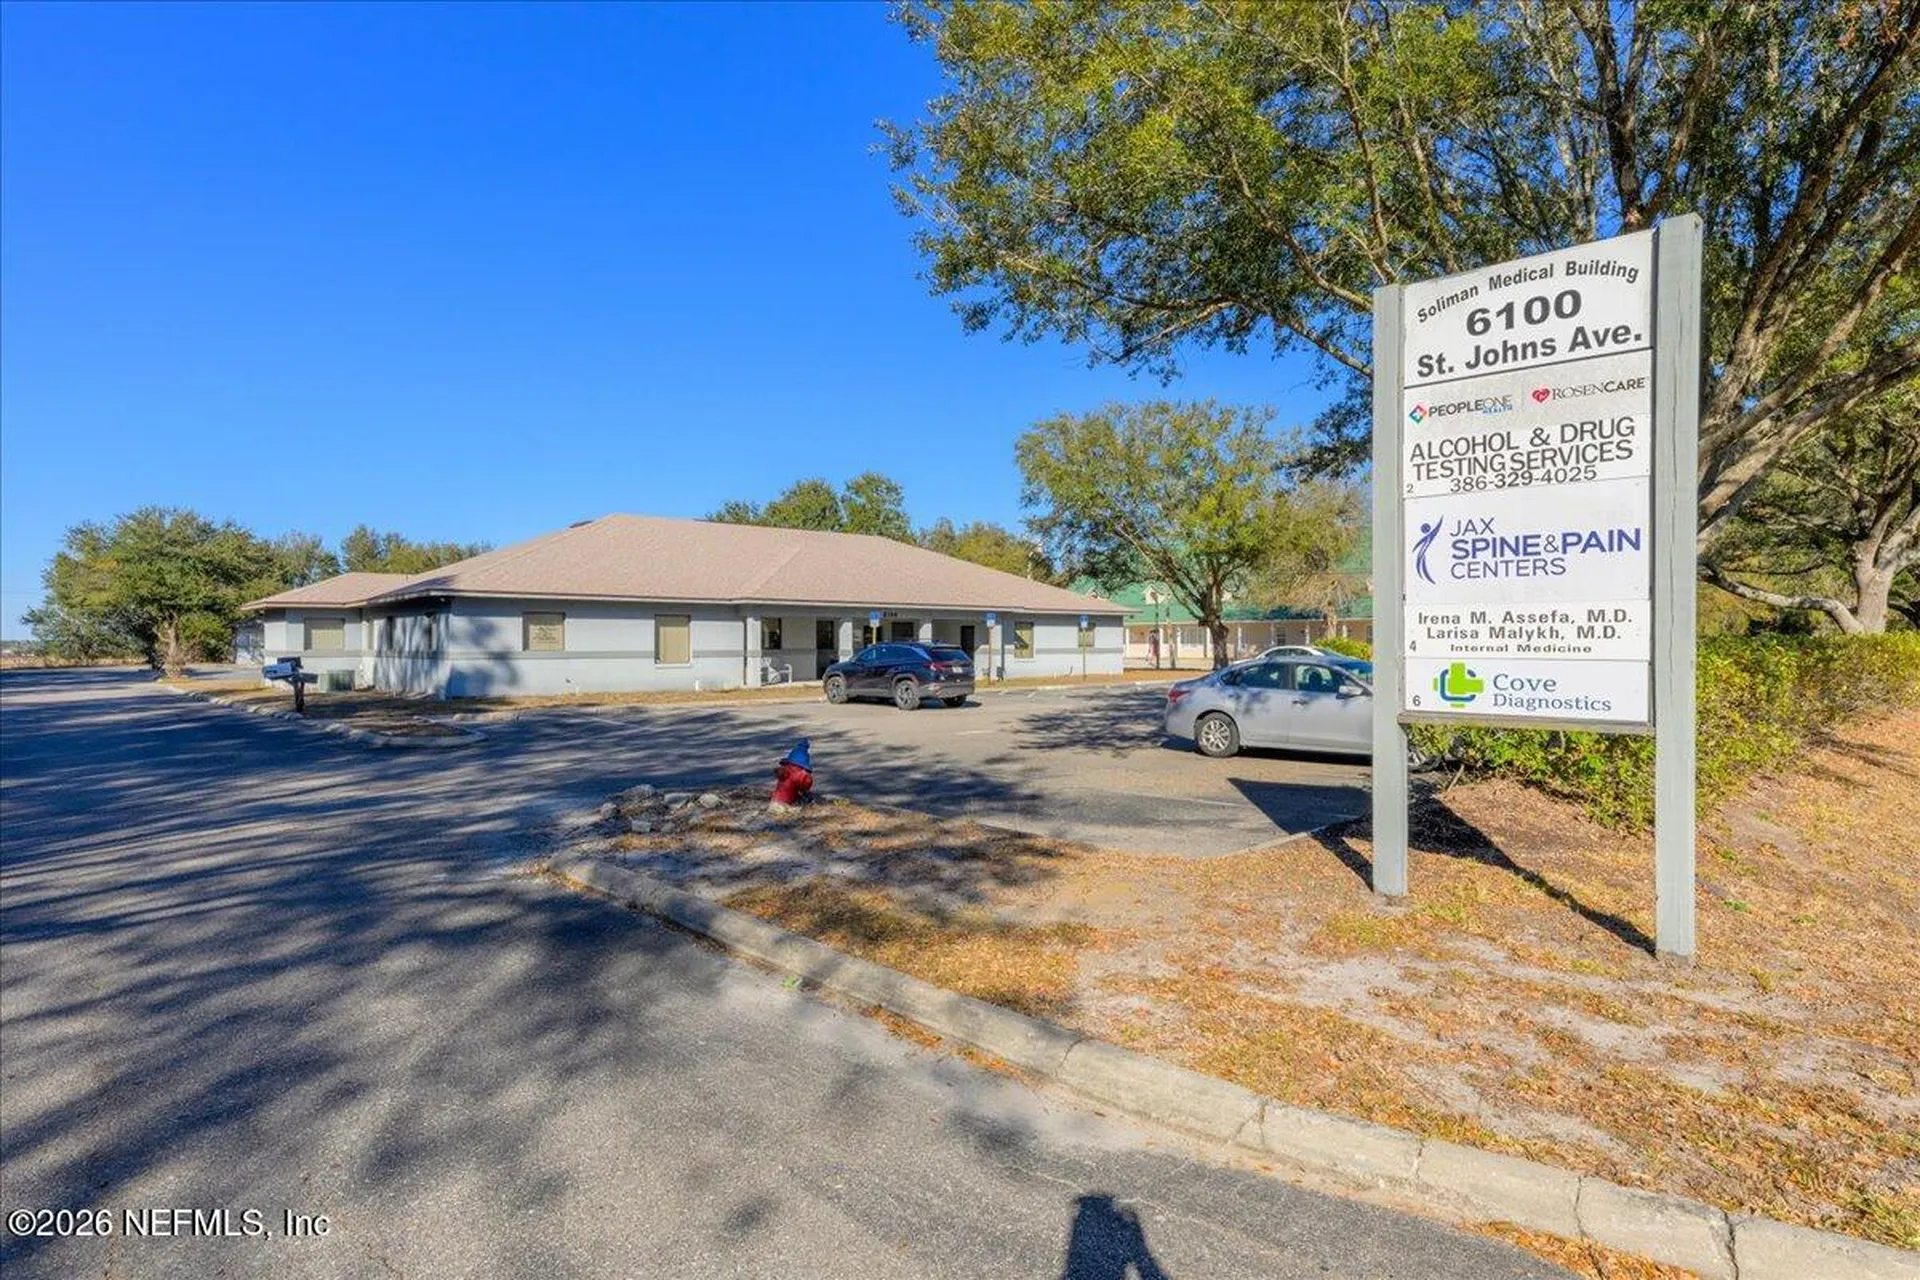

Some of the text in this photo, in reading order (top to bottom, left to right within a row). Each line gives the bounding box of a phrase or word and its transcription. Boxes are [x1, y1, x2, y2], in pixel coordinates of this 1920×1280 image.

[1416, 260, 1639, 323] Soliman Medical Building
[1466, 289, 1582, 337] 6100
[1416, 323, 1642, 378] St. Johns Ave.
[1410, 416, 1635, 462] ALCOHOL & DRUG
[1413, 440, 1634, 482] TESTING SERVICES
[1406, 483, 1414, 494] 2
[1450, 465, 1597, 494] 386-329-4025
[1450, 517, 1495, 537] JAX
[1451, 557, 1566, 580] CENTERS
[1418, 609, 1633, 626] Irena M. Assefa, M.D.
[1426, 625, 1622, 644] Larisa Malykh, M.D.
[1409, 640, 1417, 652] 4
[1450, 643, 1592, 654] Internal Medicine
[1493, 673, 1557, 692] Cove
[1412, 695, 1421, 707] 6
[1493, 693, 1612, 712] Diagnostics
